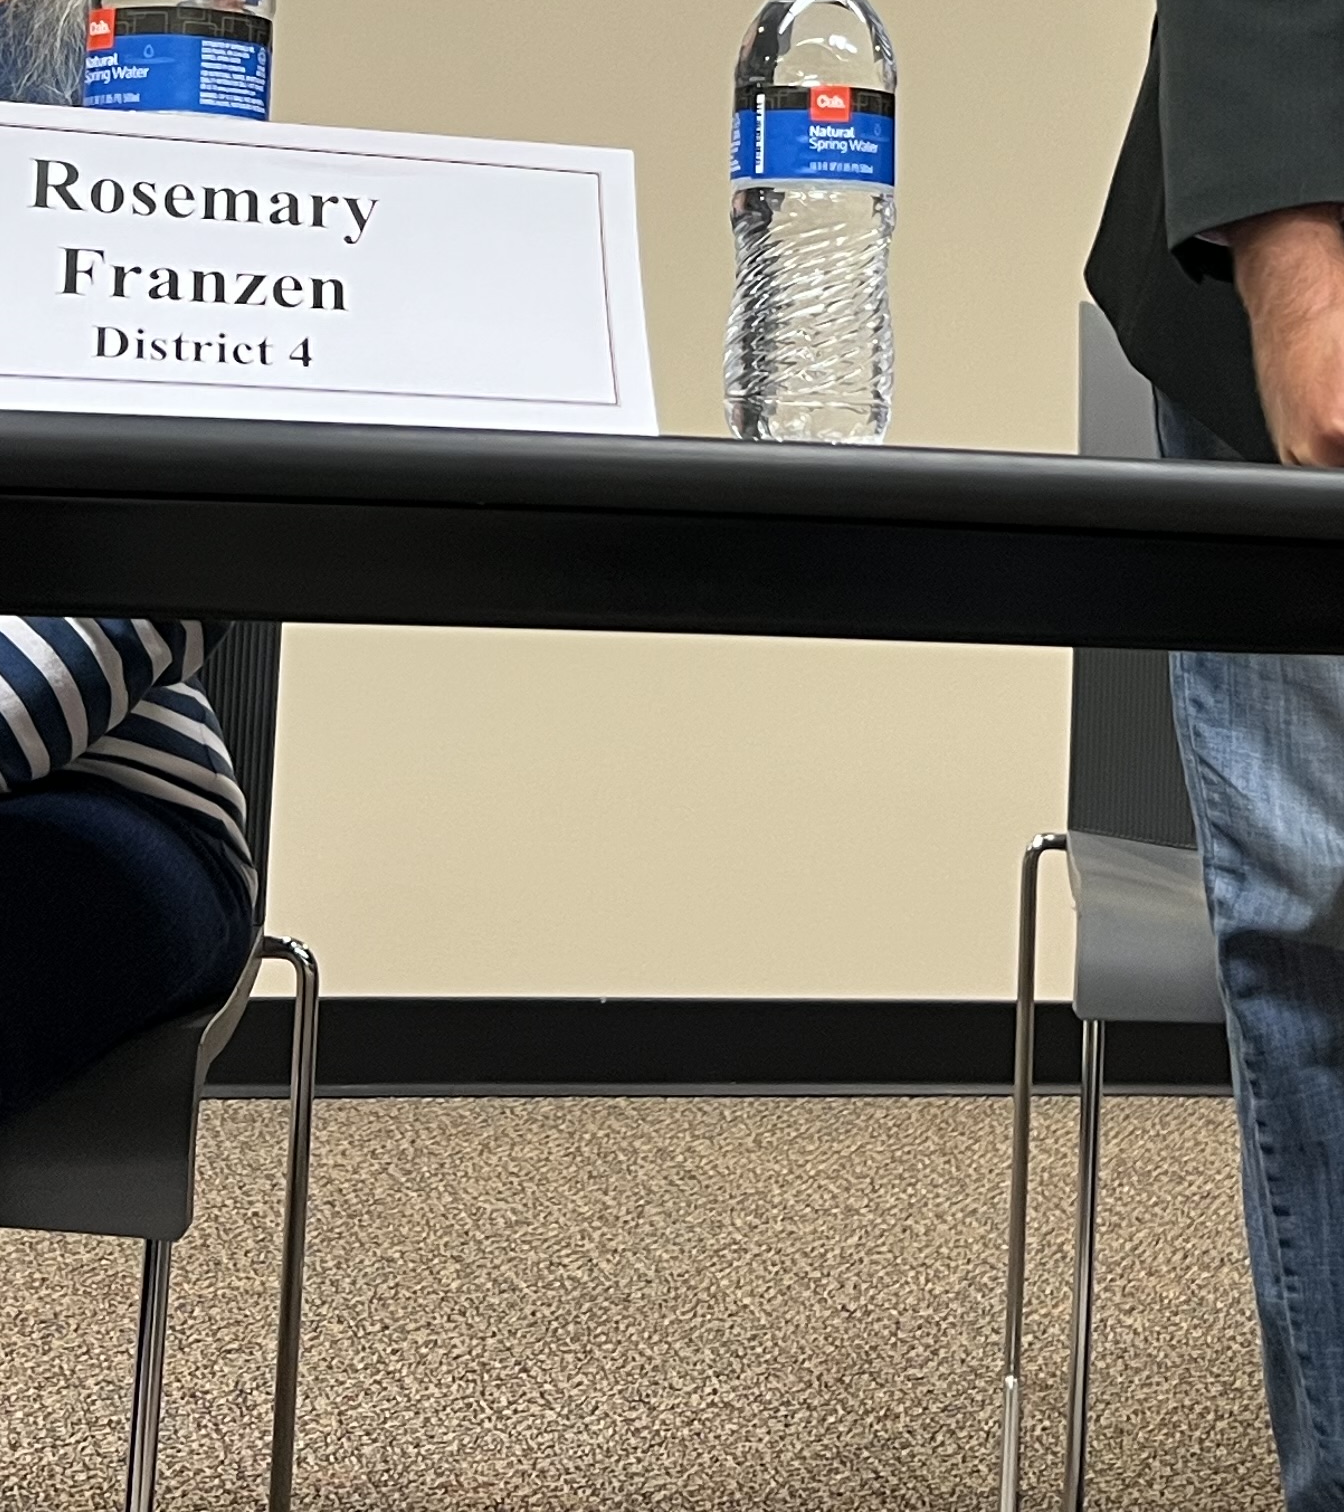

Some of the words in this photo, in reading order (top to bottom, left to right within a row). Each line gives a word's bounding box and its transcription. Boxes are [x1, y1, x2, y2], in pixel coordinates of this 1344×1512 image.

[112, 65, 149, 80] Water
[809, 125, 855, 139] Natural
[809, 137, 848, 154] Spring
[848, 139, 878, 153] Water
[30, 157, 381, 245] Rosemary
[58, 246, 349, 312] Franzen
[93, 324, 273, 367] District
[288, 335, 313, 368] 4
